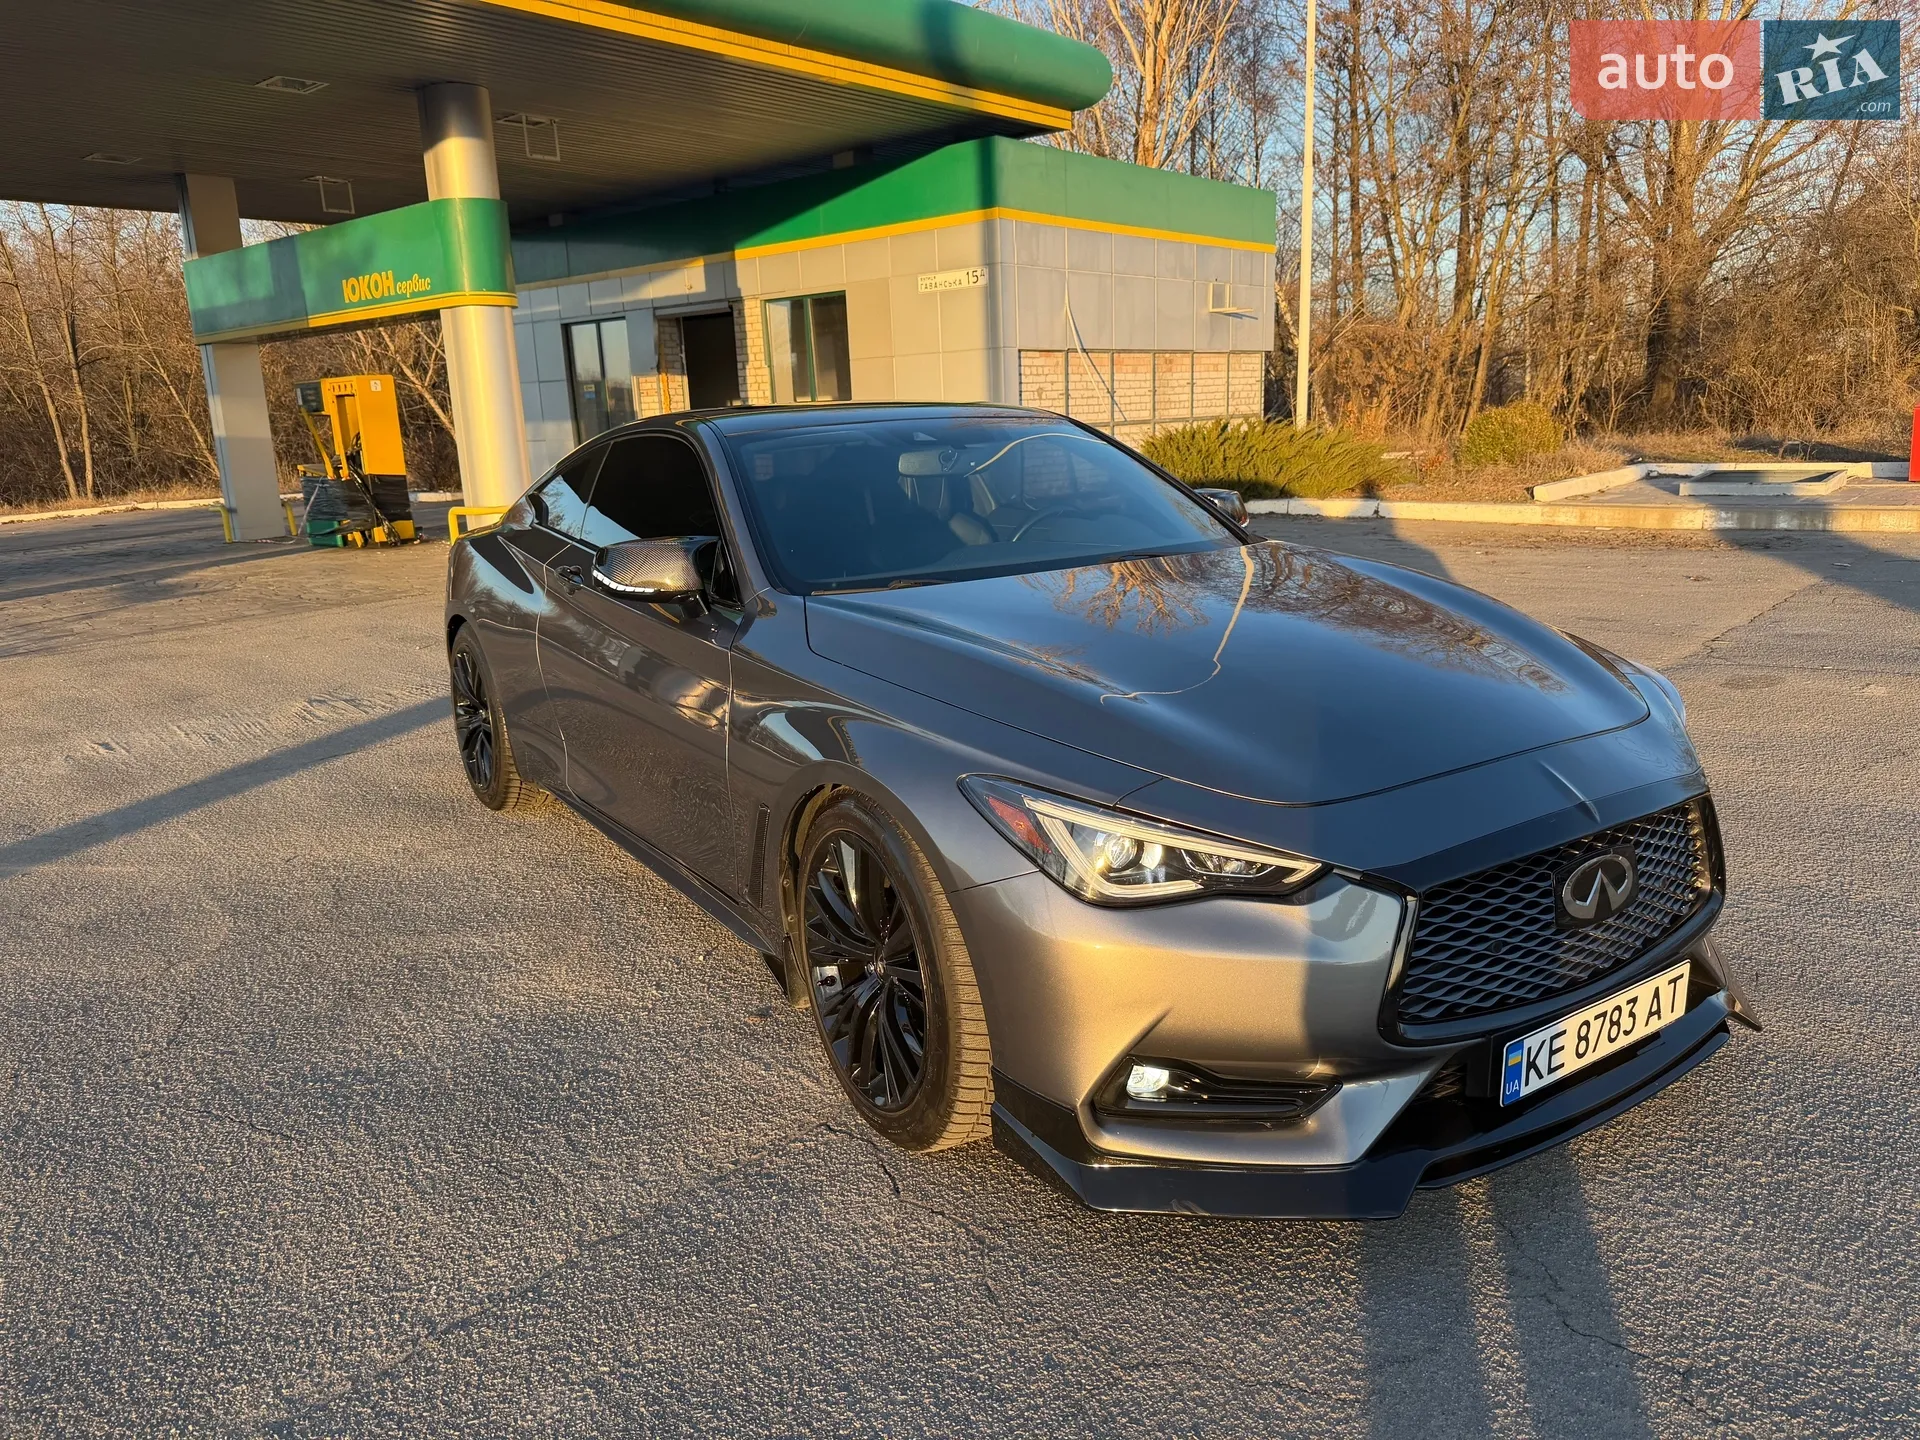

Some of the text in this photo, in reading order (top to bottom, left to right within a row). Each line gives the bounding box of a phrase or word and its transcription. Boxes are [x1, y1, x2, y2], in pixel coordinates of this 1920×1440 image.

[342, 270, 431, 303] ЮКОН сервис
[1525, 973, 1685, 1087] KE 8783 AT
[1505, 1079, 1520, 1095] UA
